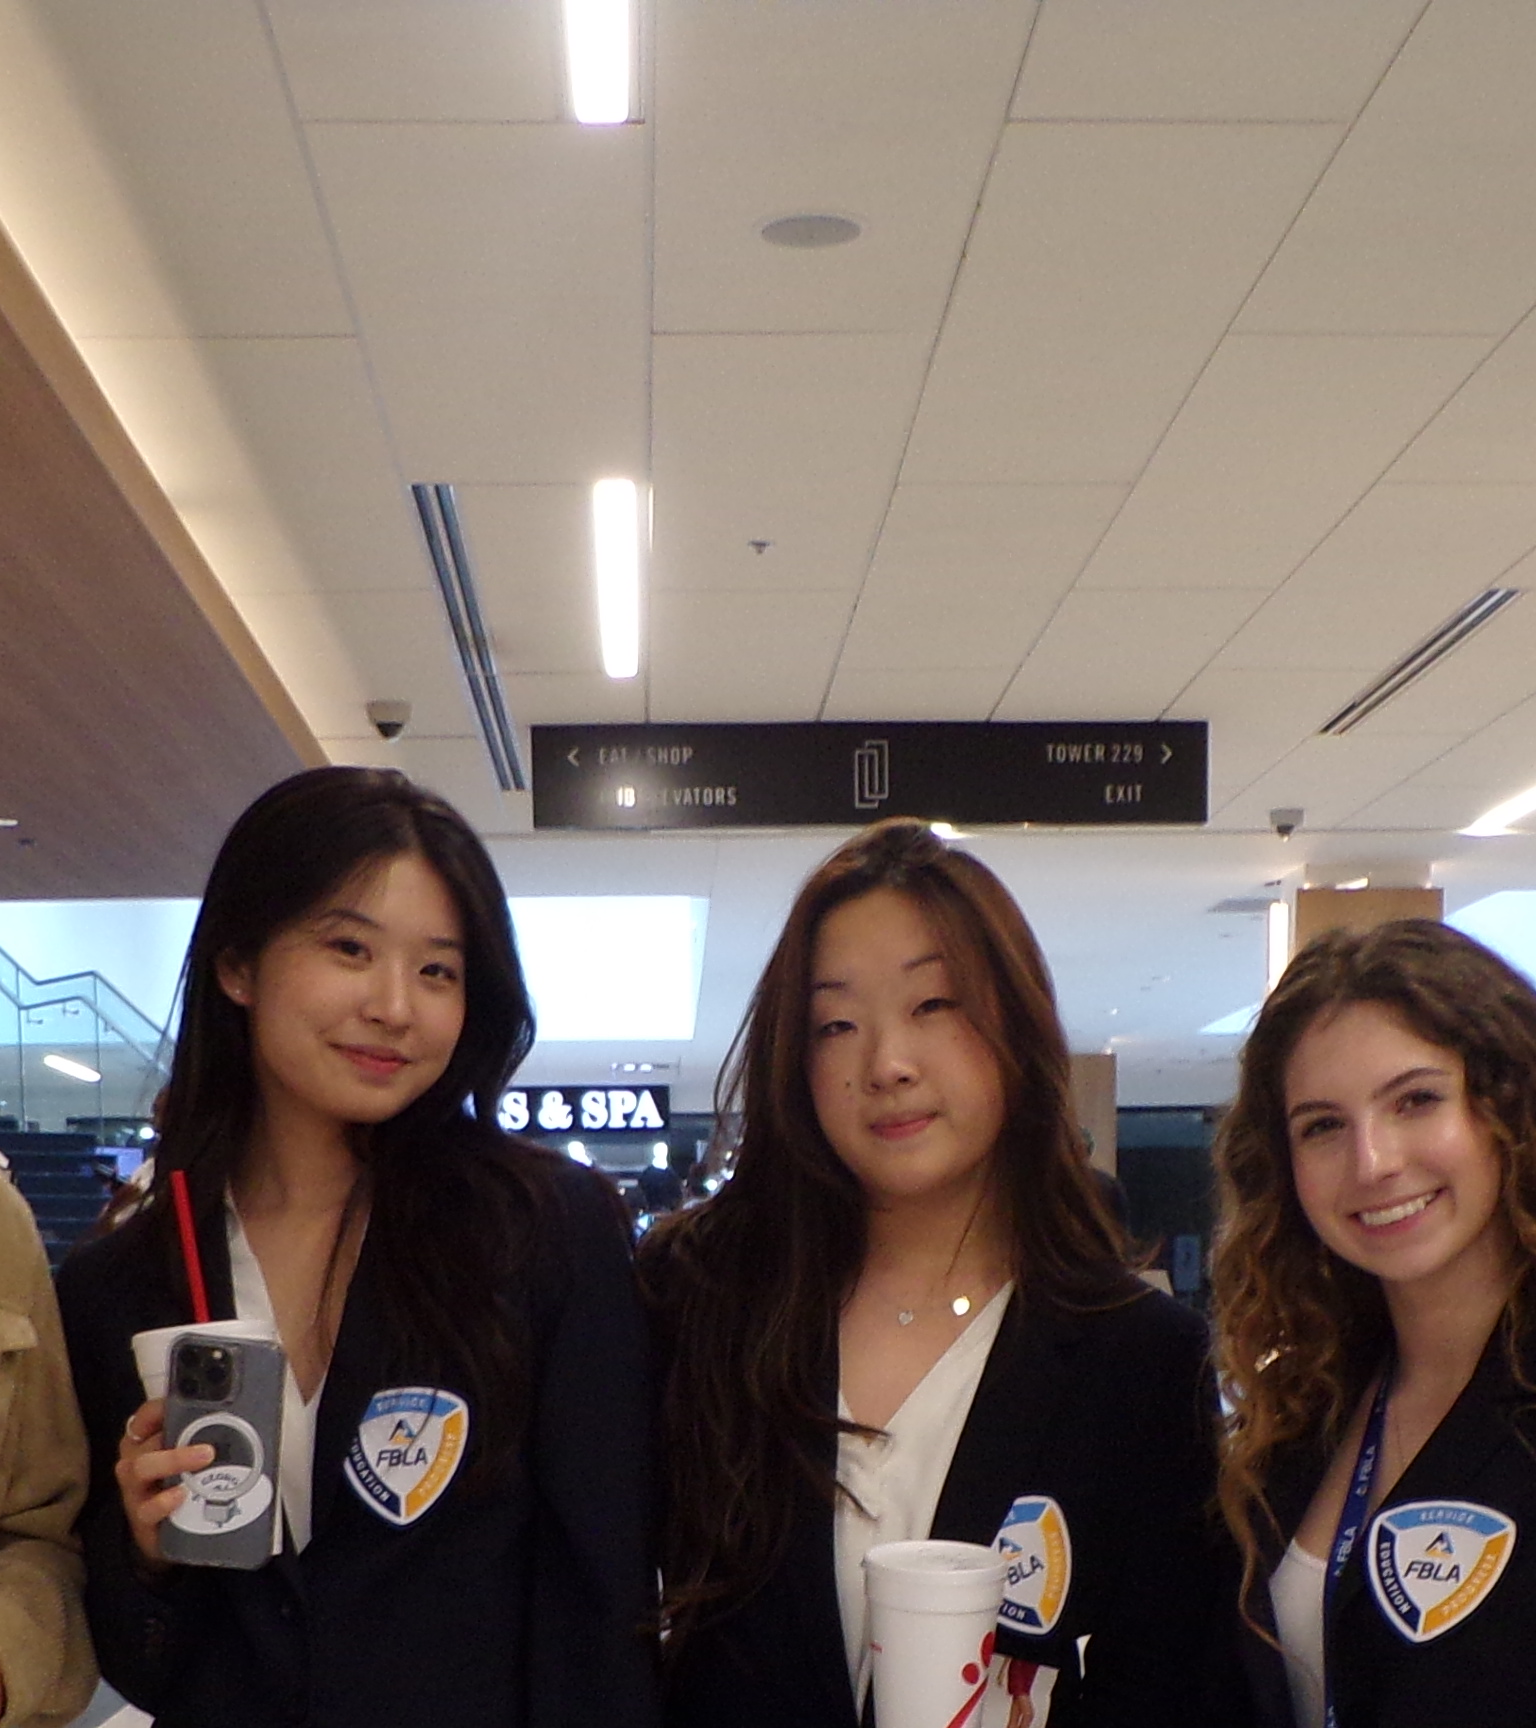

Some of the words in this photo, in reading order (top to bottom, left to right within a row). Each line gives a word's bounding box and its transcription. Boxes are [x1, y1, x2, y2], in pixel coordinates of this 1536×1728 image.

[648, 747, 693, 765] SHOP
[1047, 743, 1105, 762] TOWER
[1111, 743, 1143, 762] 229
[1105, 784, 1143, 804] EXIT
[538, 1090, 573, 1130] &
[581, 1090, 664, 1130] SPA
[376, 1447, 428, 1468] FBLA
[1004, 1555, 1045, 1585] BLA
[1380, 1542, 1412, 1615] EDUCATION
[1404, 1561, 1461, 1582] FBLA
